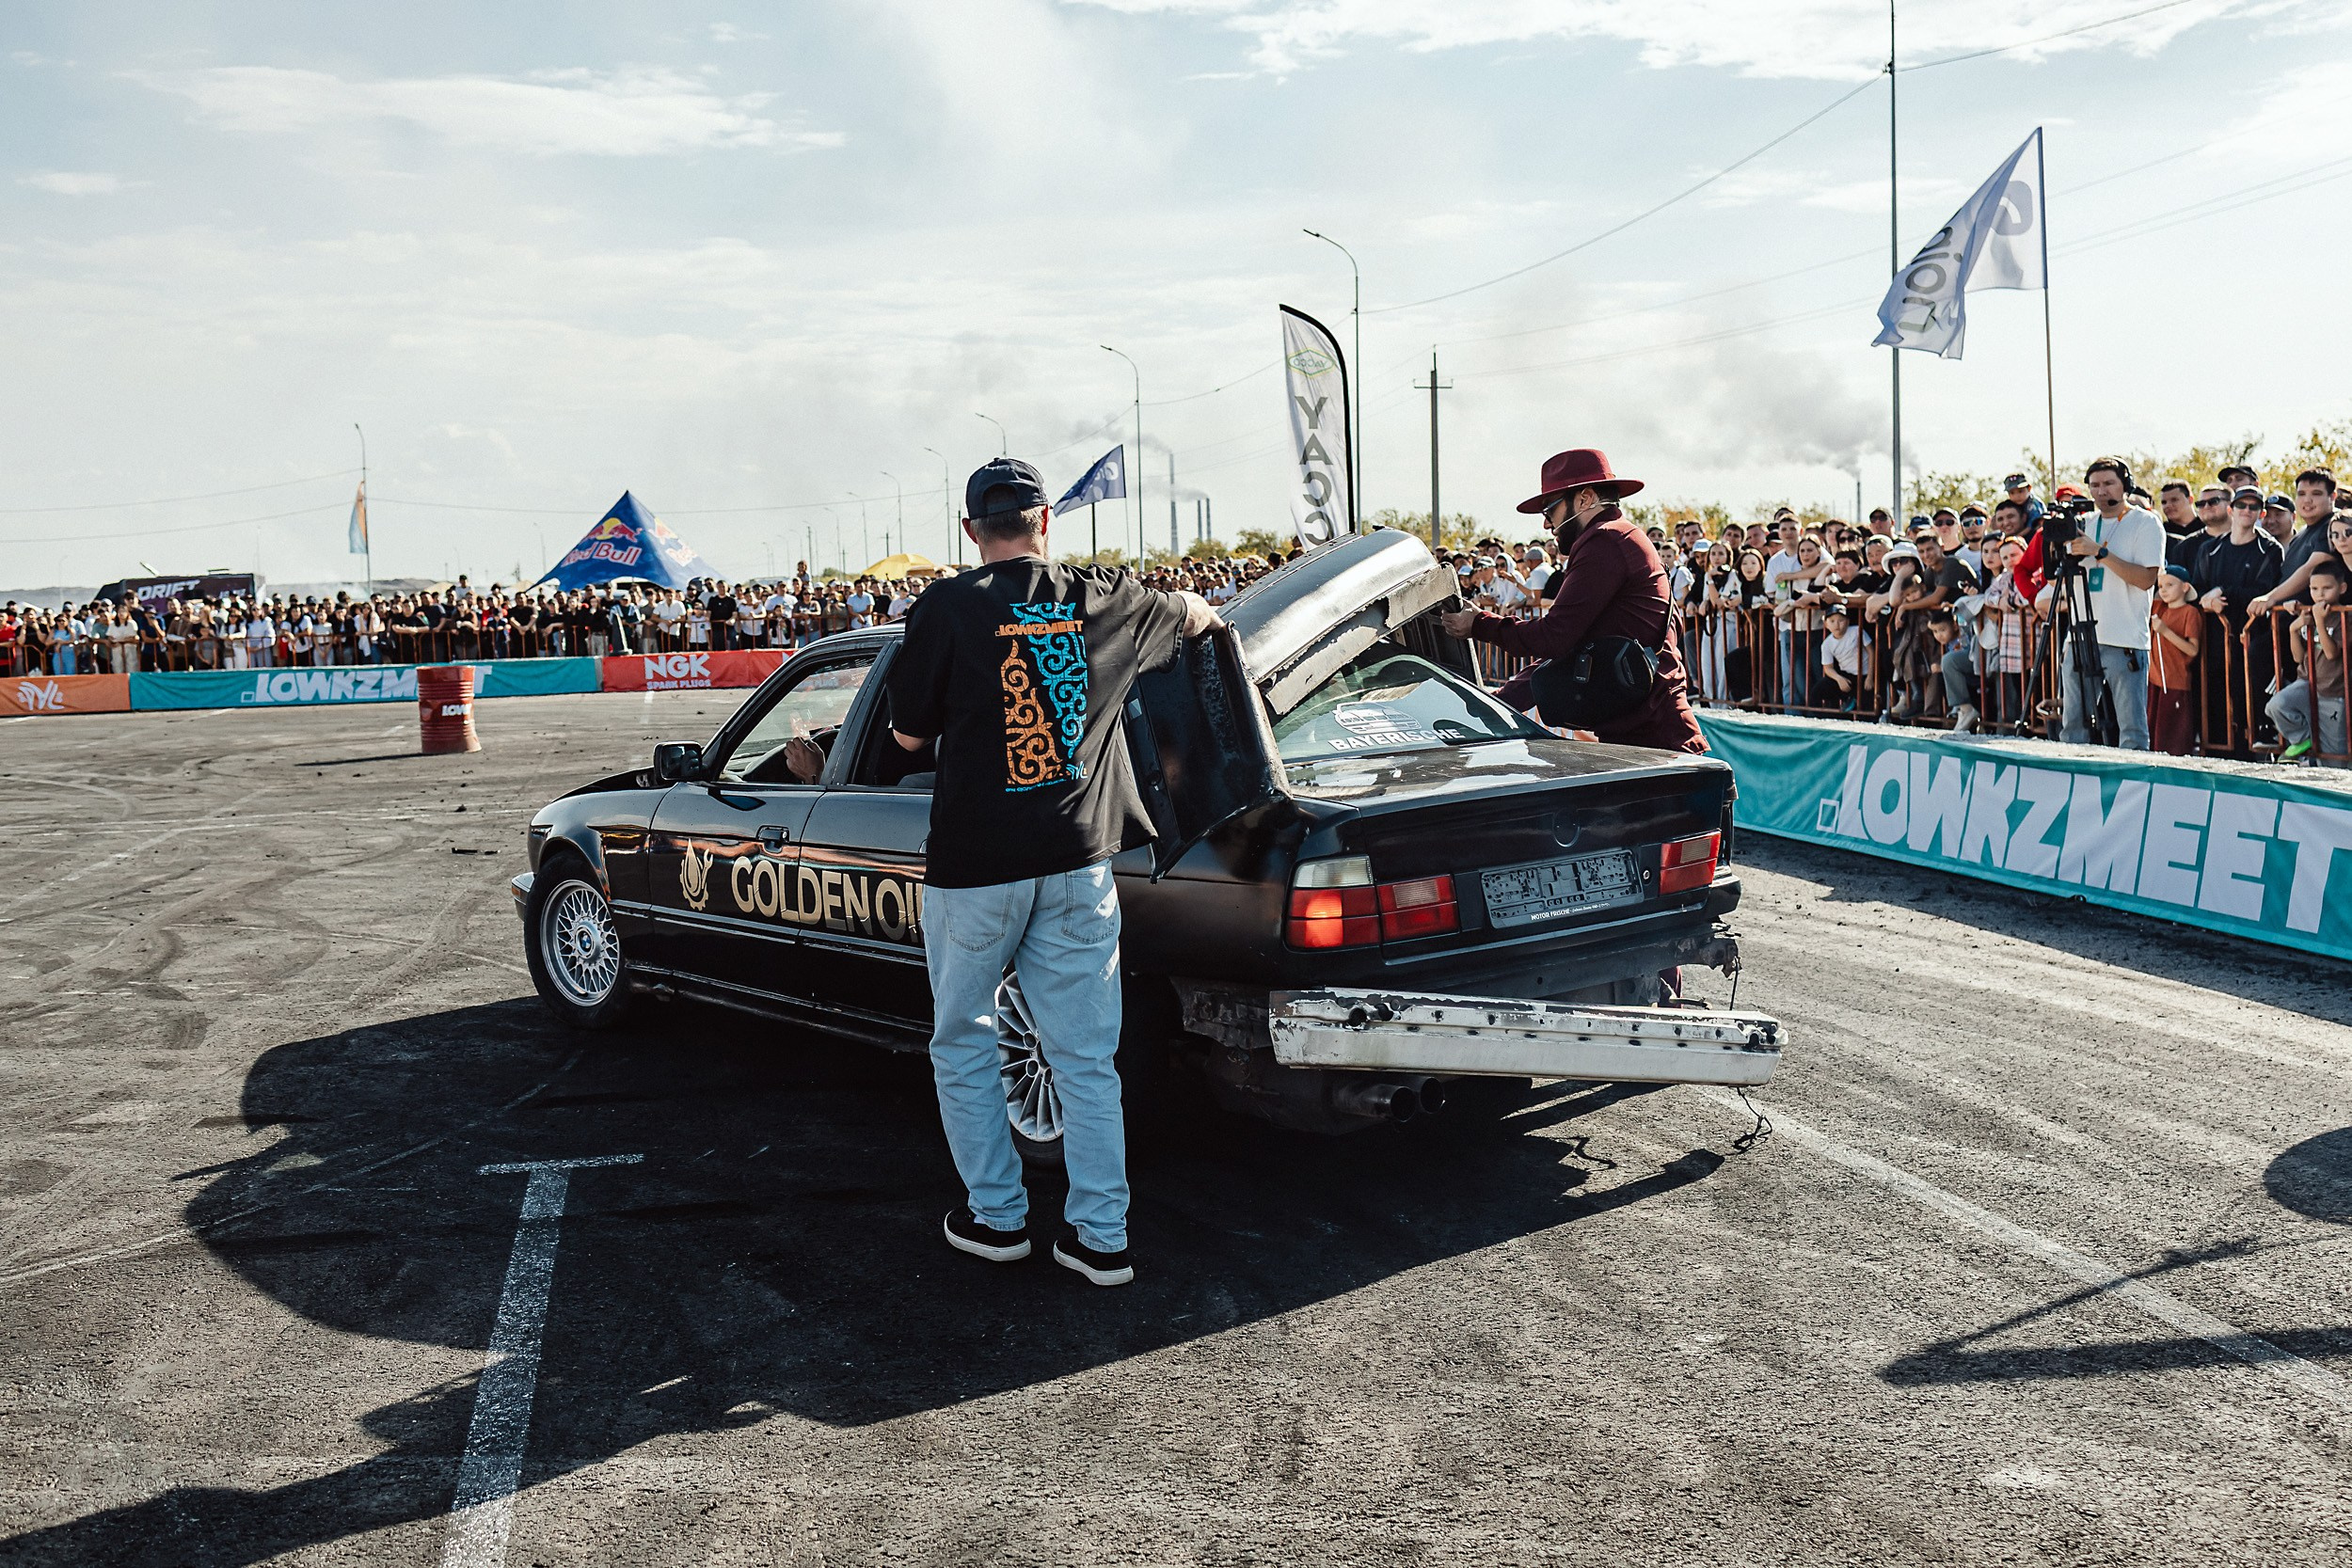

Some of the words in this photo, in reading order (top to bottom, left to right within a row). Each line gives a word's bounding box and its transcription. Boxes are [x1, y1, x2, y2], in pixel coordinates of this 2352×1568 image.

[592, 542, 642, 566] Bull
[137, 579, 201, 601] DRIFT
[644, 654, 711, 680] NGK
[646, 680, 677, 690] SPARK
[679, 678, 711, 689] PLUGS
[1327, 728, 1466, 751] BAYERISCHE
[731, 855, 874, 936] GOLDEN
[1531, 911, 1550, 921] MOTOR
